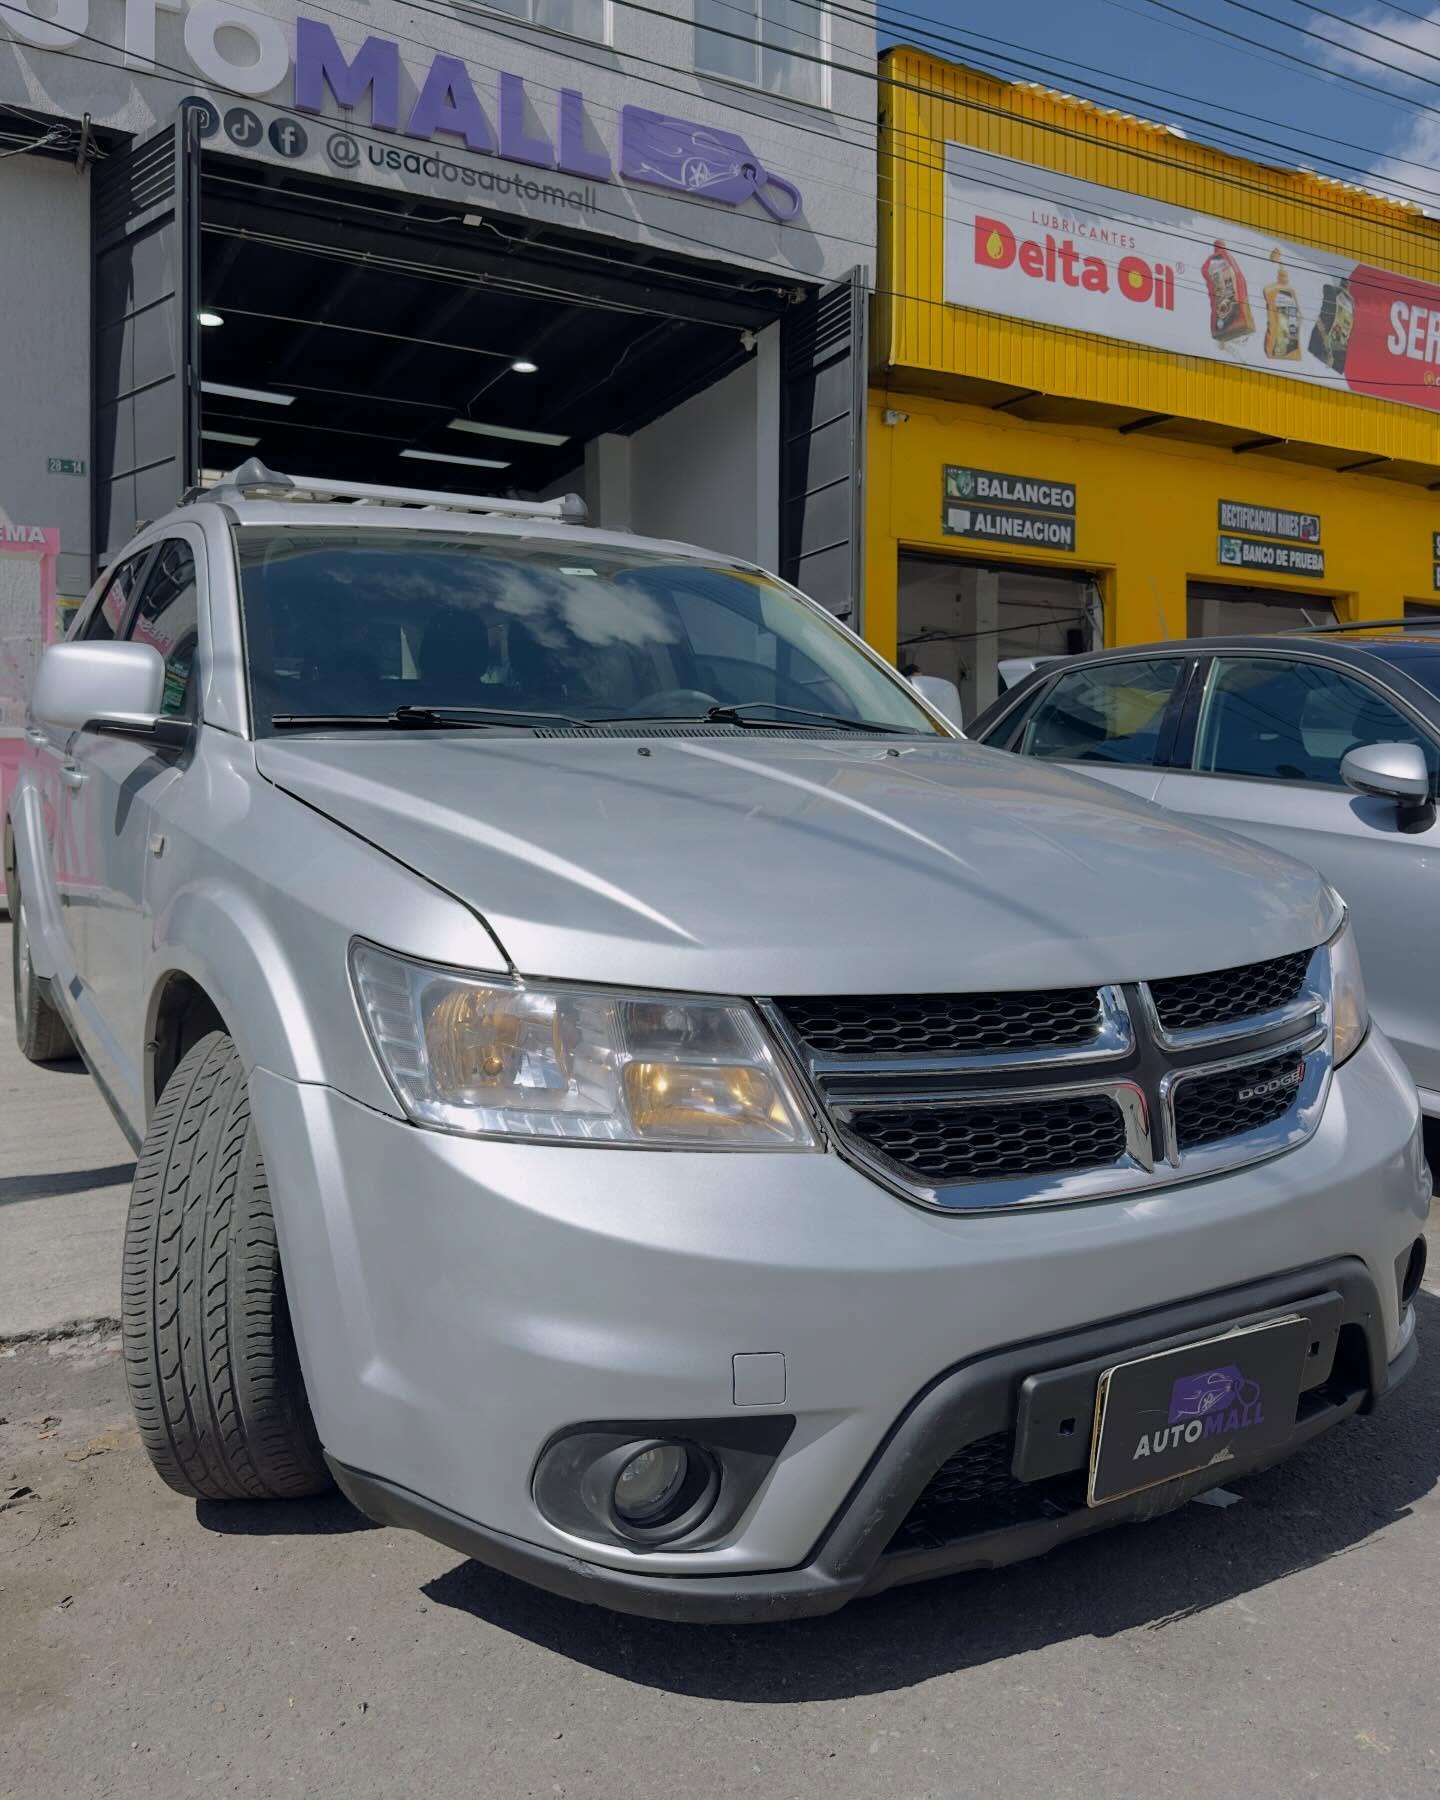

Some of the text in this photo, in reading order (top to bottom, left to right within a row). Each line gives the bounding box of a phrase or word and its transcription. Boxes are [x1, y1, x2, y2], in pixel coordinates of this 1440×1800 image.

[1031, 210, 1137, 249] LUBRICANTES
[974, 215, 1110, 294] Delta
[976, 477, 1075, 508] BALANCEO
[974, 513, 1072, 544] ALINEACION
[1242, 544, 1324, 571] BANCO DE PRUEBA
[1239, 1070, 1300, 1099] DODGE
[1132, 1402, 1264, 1461] AUTOMALL
